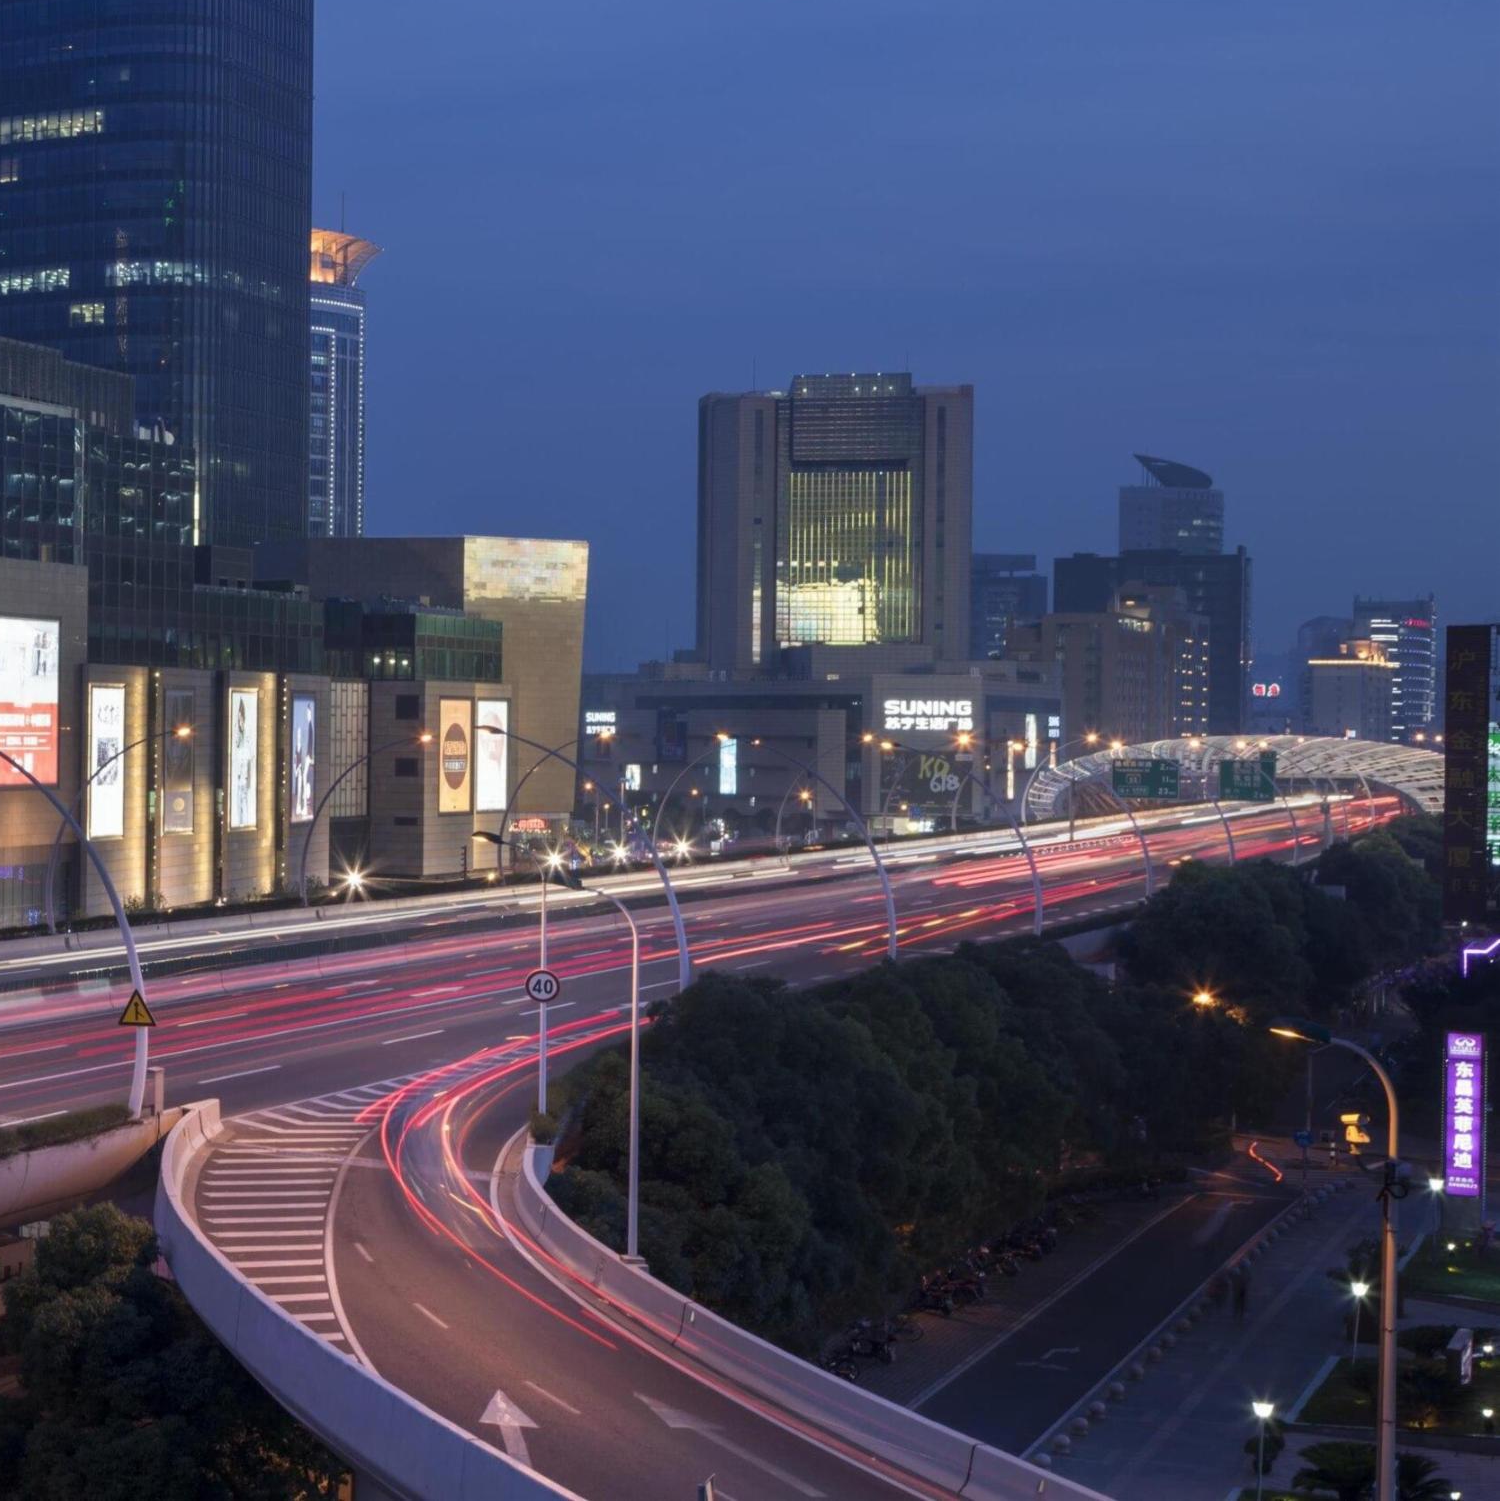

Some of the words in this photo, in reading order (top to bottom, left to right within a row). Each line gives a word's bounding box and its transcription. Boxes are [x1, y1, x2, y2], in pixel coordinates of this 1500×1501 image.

[884, 699, 972, 716] SUNING
[585, 711, 616, 723] SUNING
[929, 773, 961, 794] 618
[532, 978, 554, 994] 40
